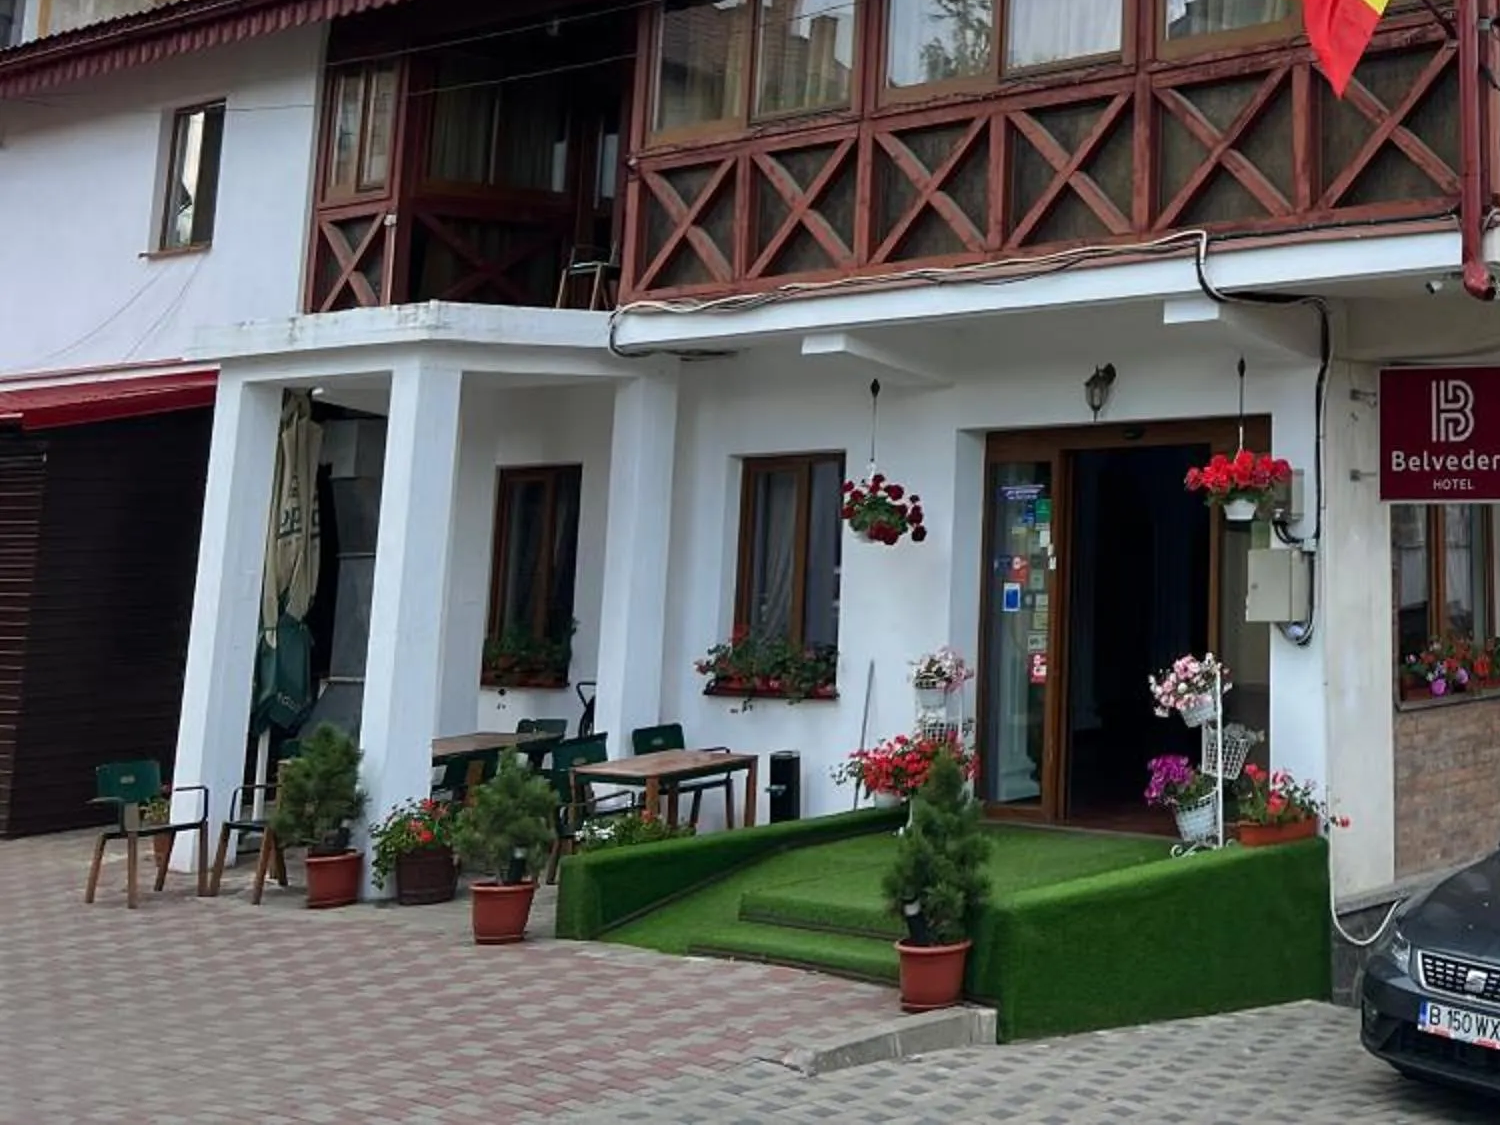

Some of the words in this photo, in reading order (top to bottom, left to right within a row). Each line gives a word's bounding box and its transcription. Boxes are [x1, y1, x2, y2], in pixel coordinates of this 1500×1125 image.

[1433, 478, 1474, 490] HOTEL
[1429, 1004, 1441, 1026] B
[1447, 1008, 1473, 1034] 150
